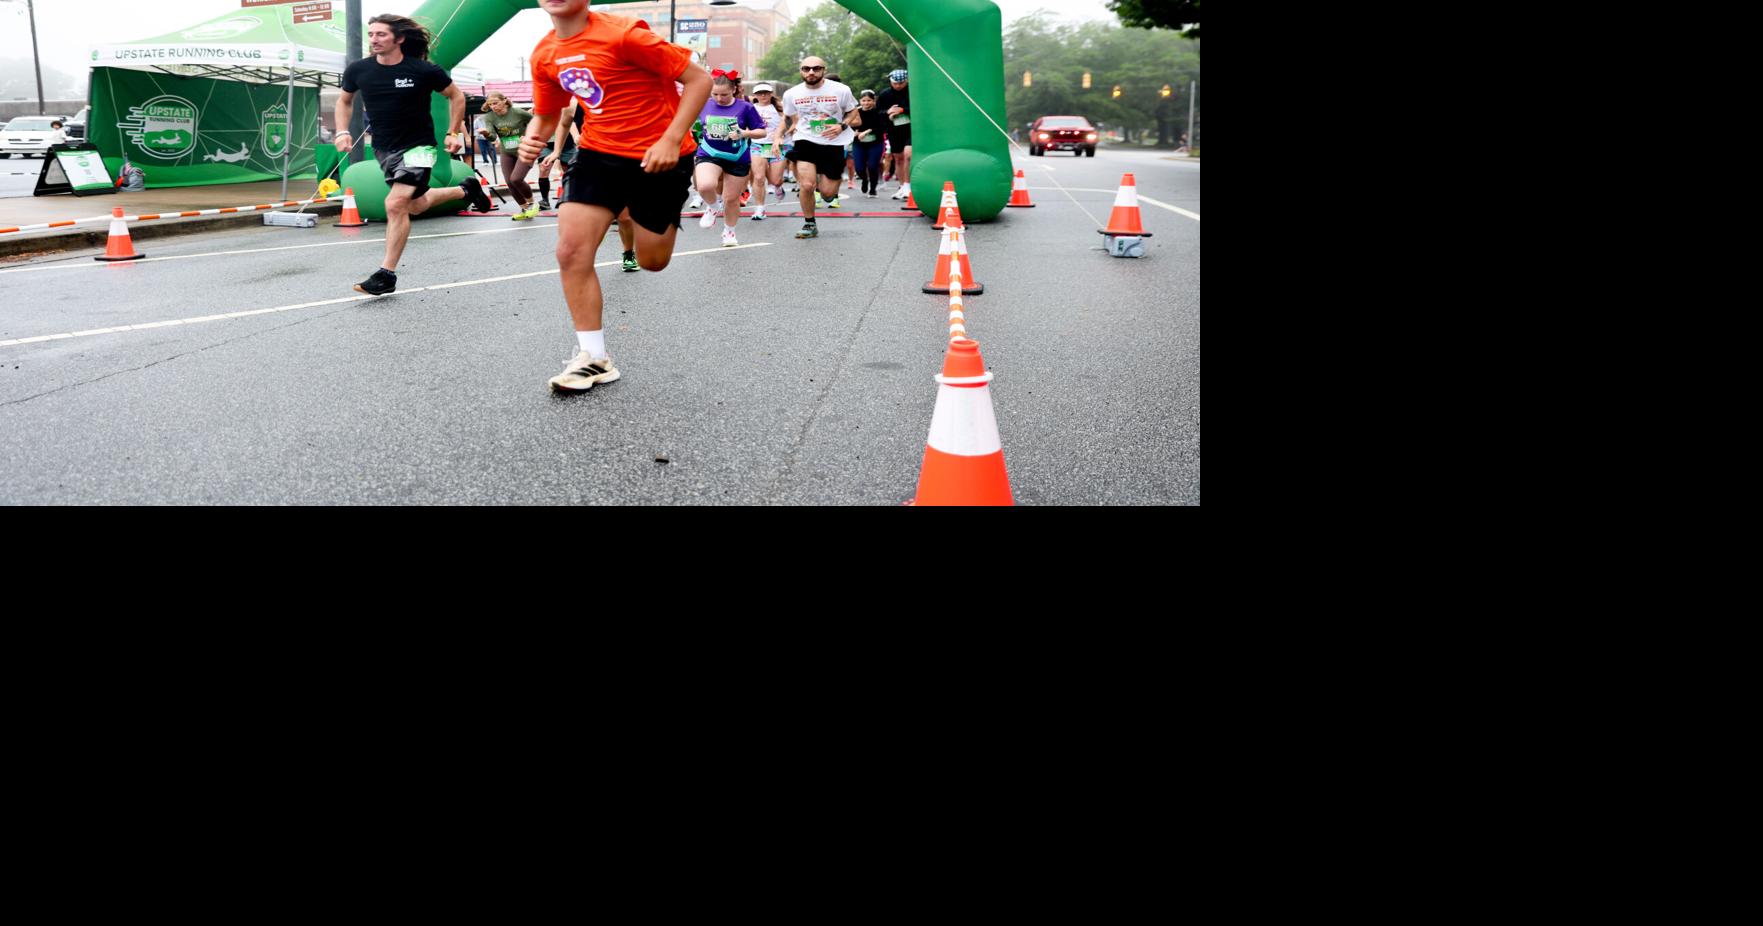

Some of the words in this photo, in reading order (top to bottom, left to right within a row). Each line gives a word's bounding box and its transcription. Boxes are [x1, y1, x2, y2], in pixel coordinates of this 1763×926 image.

[115, 49, 165, 59] UPSTATE
[169, 47, 225, 58] RUNNING
[149, 105, 191, 117] UPSTATE
